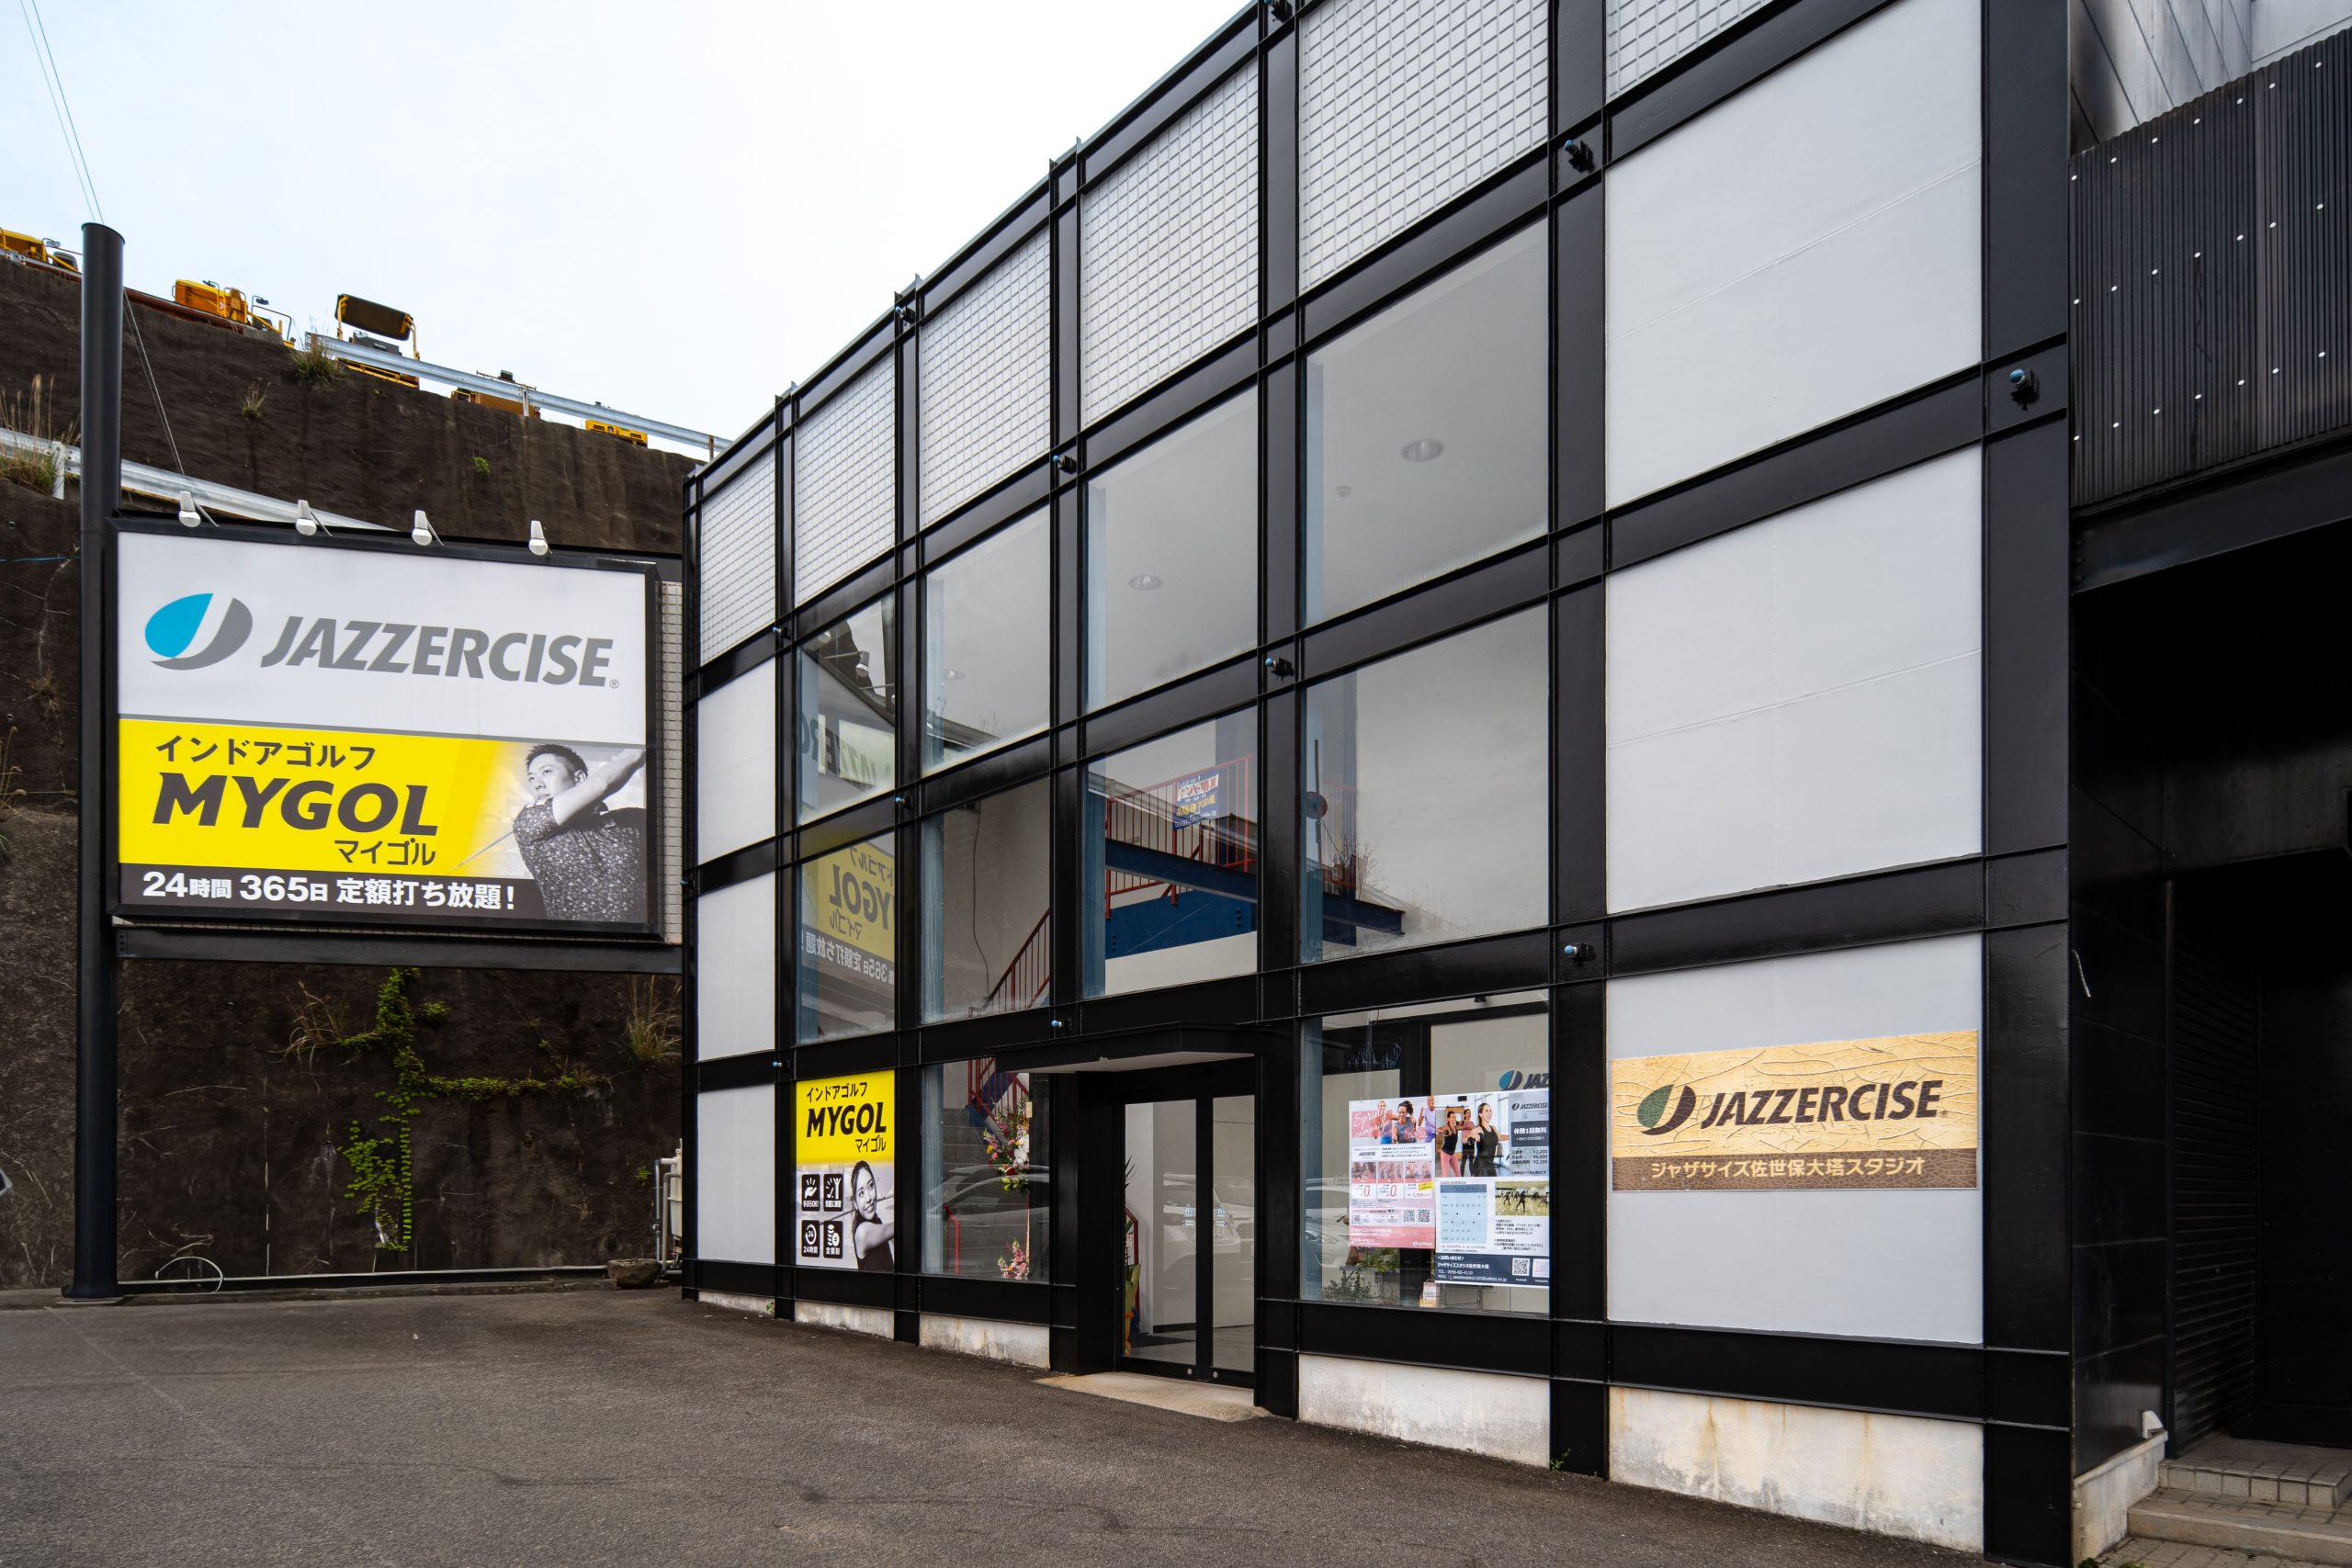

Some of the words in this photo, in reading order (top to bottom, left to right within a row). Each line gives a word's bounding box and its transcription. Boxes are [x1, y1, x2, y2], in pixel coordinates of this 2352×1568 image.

[260, 615, 614, 687] JAZZERCISE
[155, 735, 376, 771] インドアゴルフ
[153, 772, 437, 836] MYGOL
[334, 837, 436, 866] マイゴル
[142, 871, 232, 899] 24時間
[239, 874, 329, 902] 365日
[807, 1082, 867, 1102] インドアゴルフ
[1520, 1102, 1548, 1111] JAZZERCISE
[1701, 1079, 1944, 1130] JAZZERCISE
[807, 1102, 887, 1138] MYGOL
[855, 1134, 887, 1153] マイゴル
[1651, 1156, 1926, 1179] ジャザサイズ佐世保大塔スタジオ
